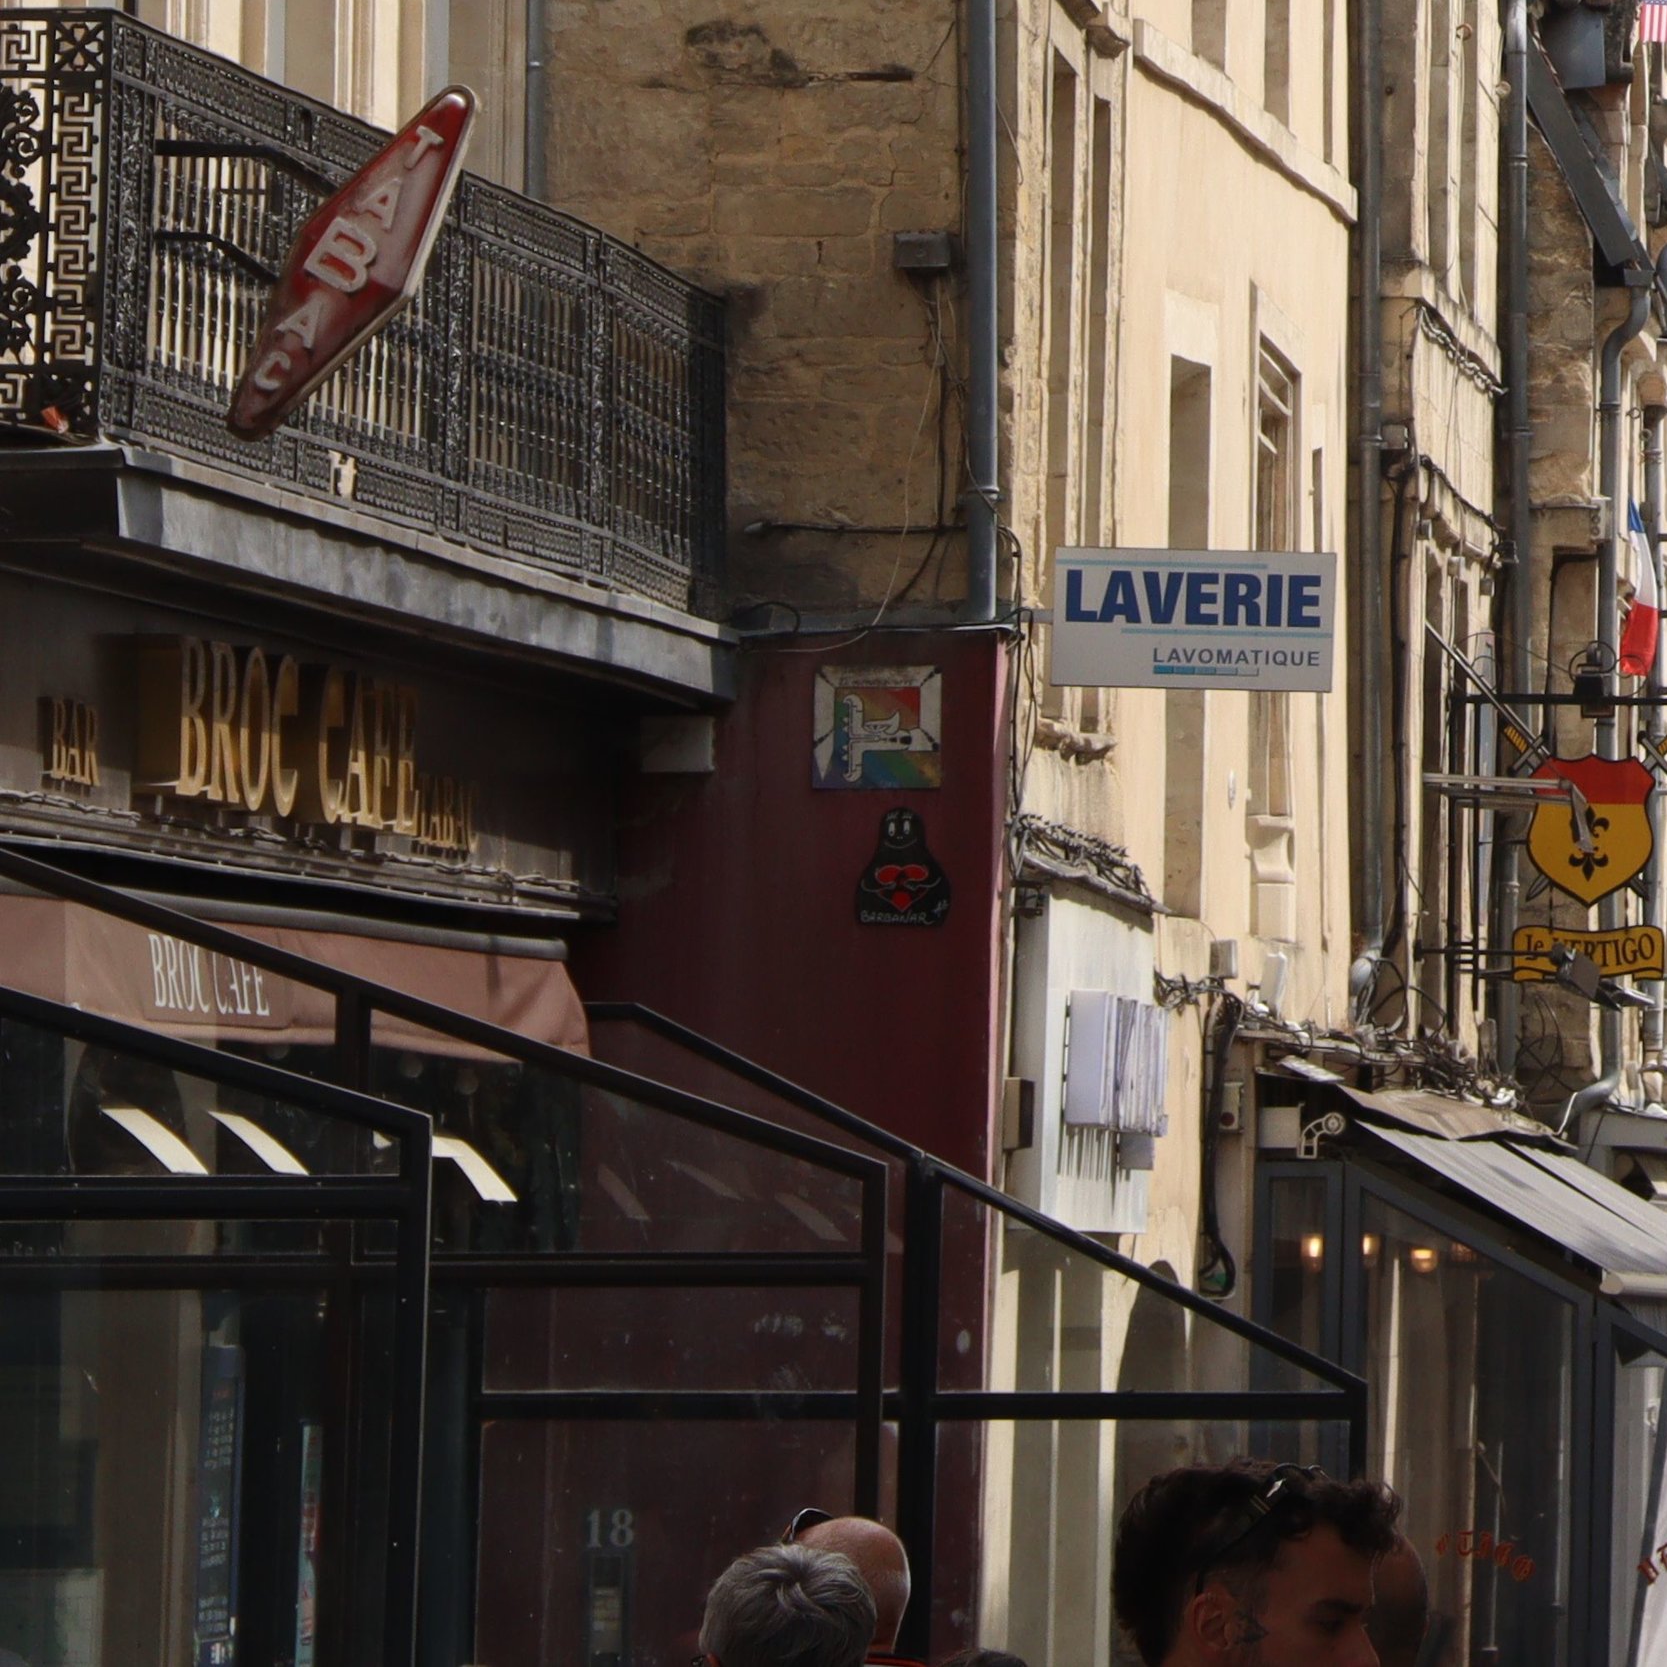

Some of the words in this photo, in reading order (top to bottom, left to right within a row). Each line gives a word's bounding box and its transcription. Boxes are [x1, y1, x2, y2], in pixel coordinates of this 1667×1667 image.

[252, 123, 446, 393] TABAC
[1065, 569, 1322, 628] LAVERIE
[1152, 647, 1321, 667] LAVOMATIQUE
[51, 698, 100, 787] BAR
[174, 636, 300, 818] BROC
[148, 934, 210, 1015] BROC
[1553, 933, 1655, 967] RTIGO
[585, 1508, 635, 1549] 18
